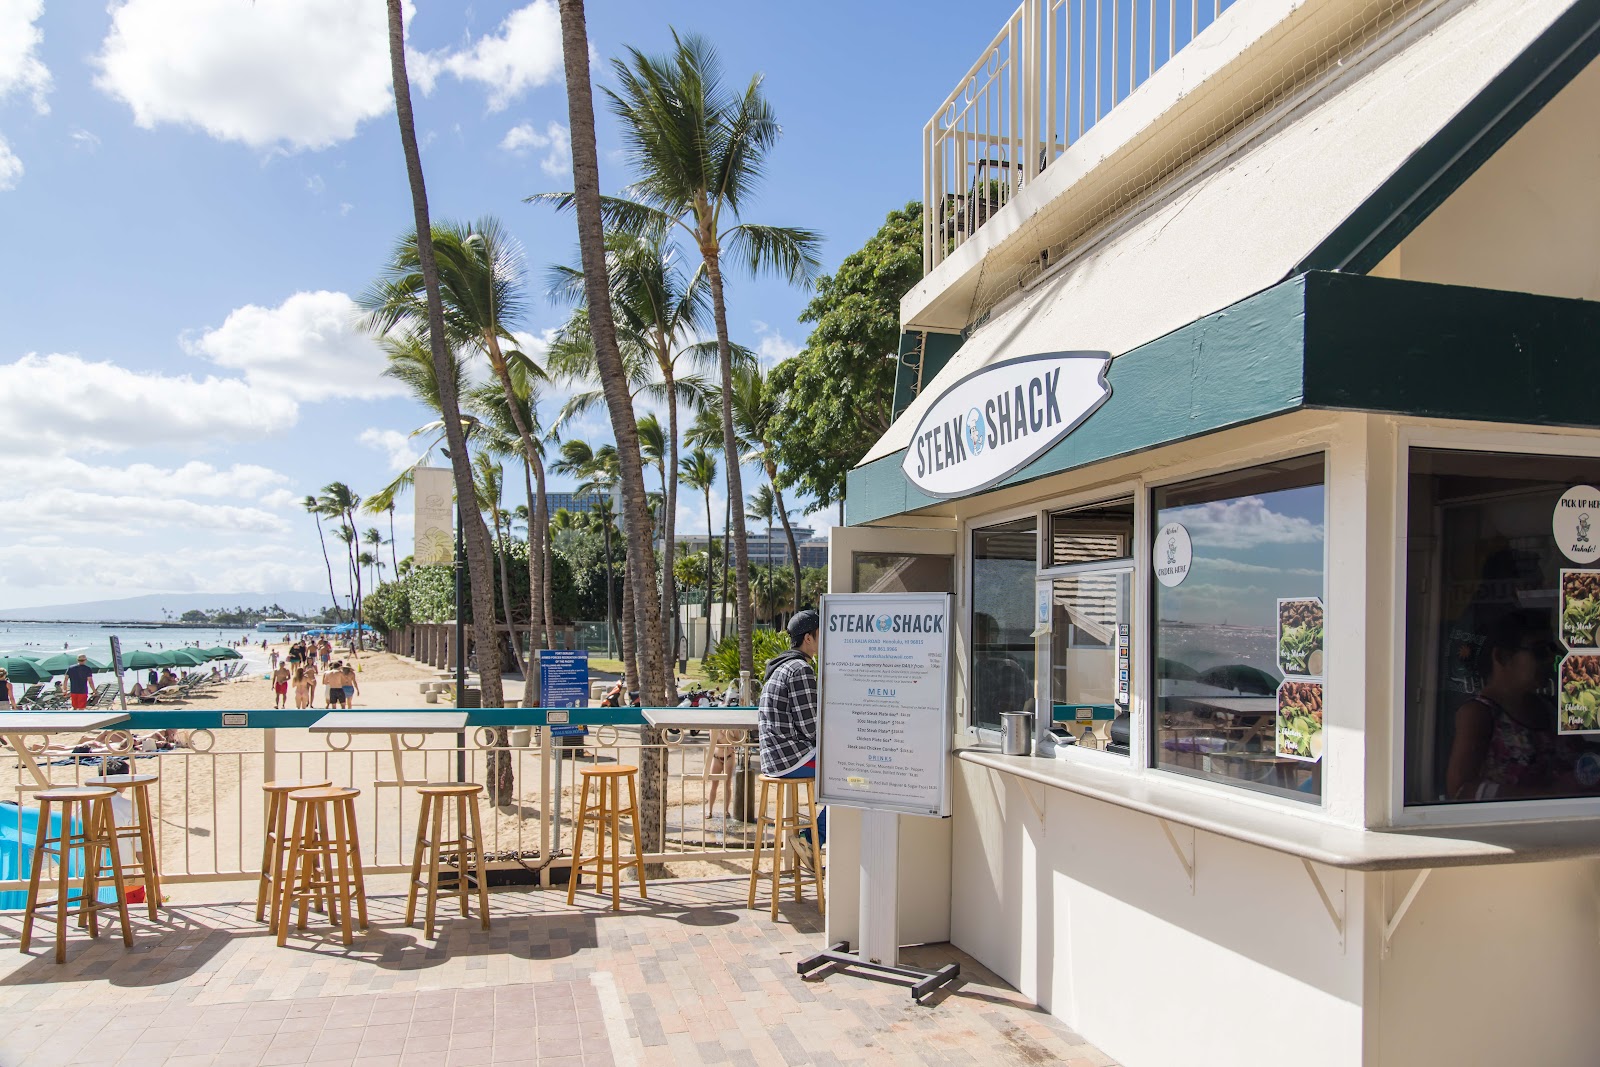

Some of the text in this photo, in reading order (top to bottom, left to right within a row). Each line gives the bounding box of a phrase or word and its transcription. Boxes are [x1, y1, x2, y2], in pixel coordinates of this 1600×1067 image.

[917, 367, 1062, 478] STEAK SHACK
[1561, 499, 1577, 508] PICK
[1578, 499, 1587, 508] UP
[1571, 544, 1596, 553] Mahalo!
[1158, 565, 1186, 576] ORDER HERE
[830, 614, 943, 633] STEAK SHACK
